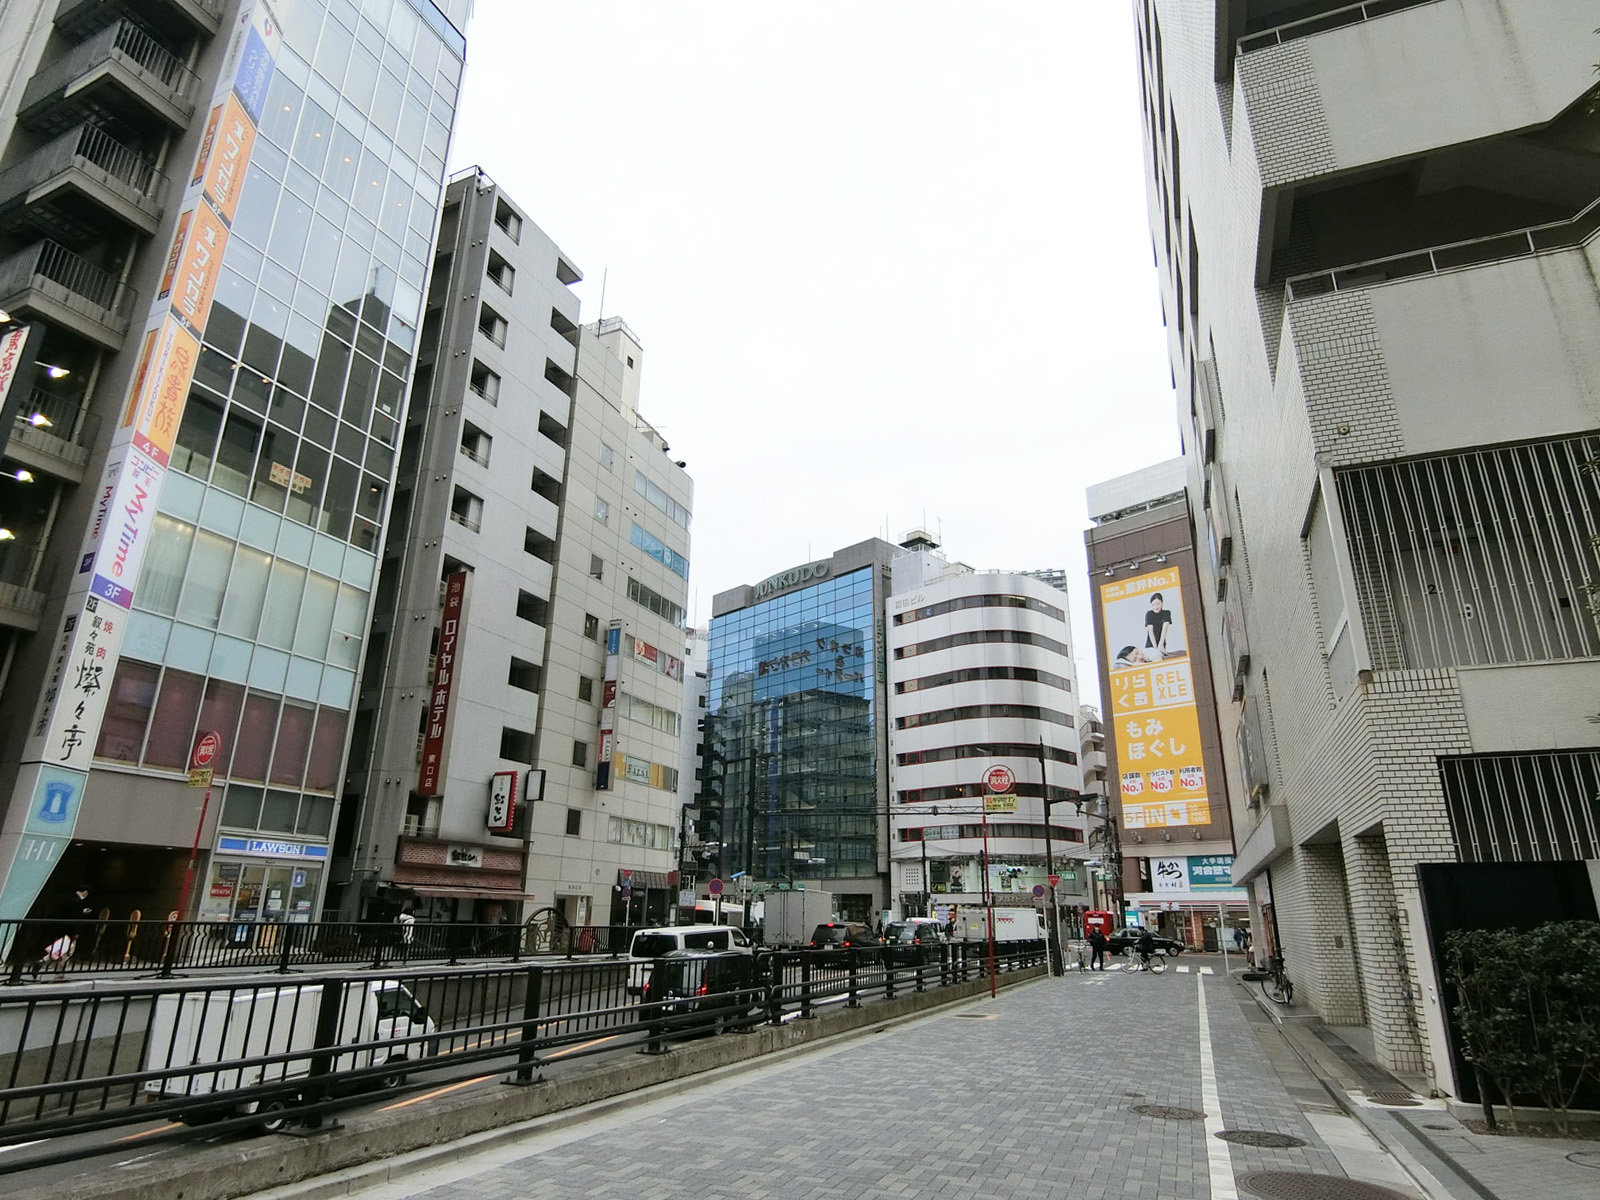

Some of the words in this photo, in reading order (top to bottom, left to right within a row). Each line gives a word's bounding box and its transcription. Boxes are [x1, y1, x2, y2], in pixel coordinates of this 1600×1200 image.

[142, 441, 159, 458] 4F
[131, 455, 160, 481] コンビニ
[92, 485, 114, 540] MyTime
[111, 484, 148, 578] MyTime
[756, 562, 829, 600] JUNKUDO
[104, 584, 121, 599] 3F
[1428, 584, 1437, 595] 2
[87, 597, 99, 611] 2F
[84, 615, 103, 656] 叙々苑
[96, 620, 114, 660] 焼肉
[429, 619, 457, 739] ロイヤルホテル
[1115, 673, 1147, 691] りら
[1155, 670, 1186, 686] REL
[1118, 692, 1149, 708] くる
[1157, 684, 1188, 700] XLE
[1126, 718, 1164, 738] もみ
[1128, 737, 1186, 760] ほぐし
[424, 754, 436, 788] 東口店
[990, 775, 1009, 784] 消火栓
[1122, 782, 1144, 793] No.1
[1150, 779, 1174, 790] No.1
[1180, 776, 1204, 788] No.1
[1126, 813, 1143, 823] 5F
[251, 841, 302, 854] LAWSON
[1202, 857, 1235, 865] 大学現役
[1157, 860, 1183, 879] 牛かつ
